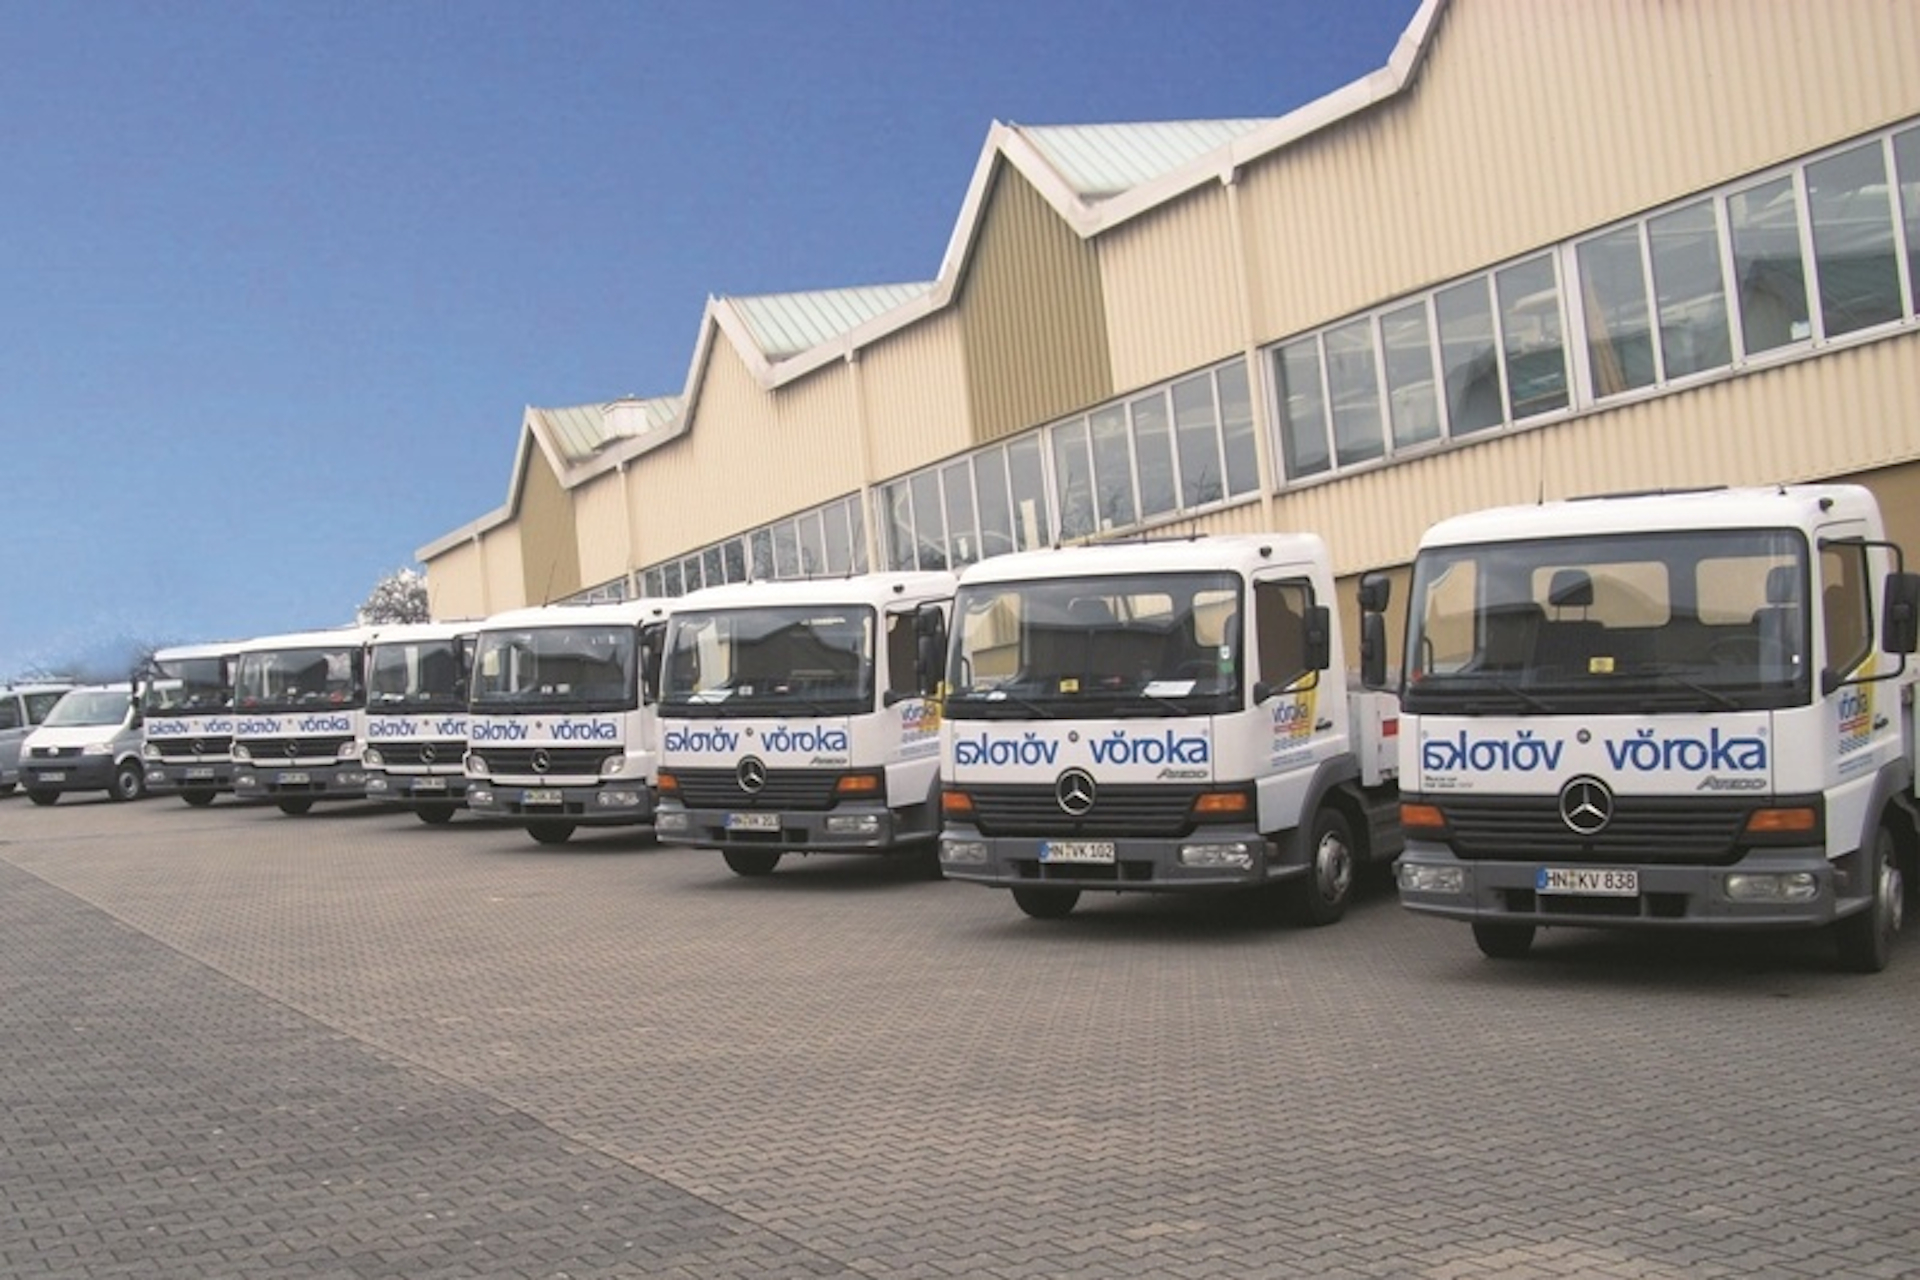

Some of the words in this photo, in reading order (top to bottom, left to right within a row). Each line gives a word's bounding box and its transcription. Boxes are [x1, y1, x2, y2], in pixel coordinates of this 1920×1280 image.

[1547, 871, 1568, 887] HN
[1579, 873, 1600, 889] KV
[1605, 873, 1636, 889] 838
